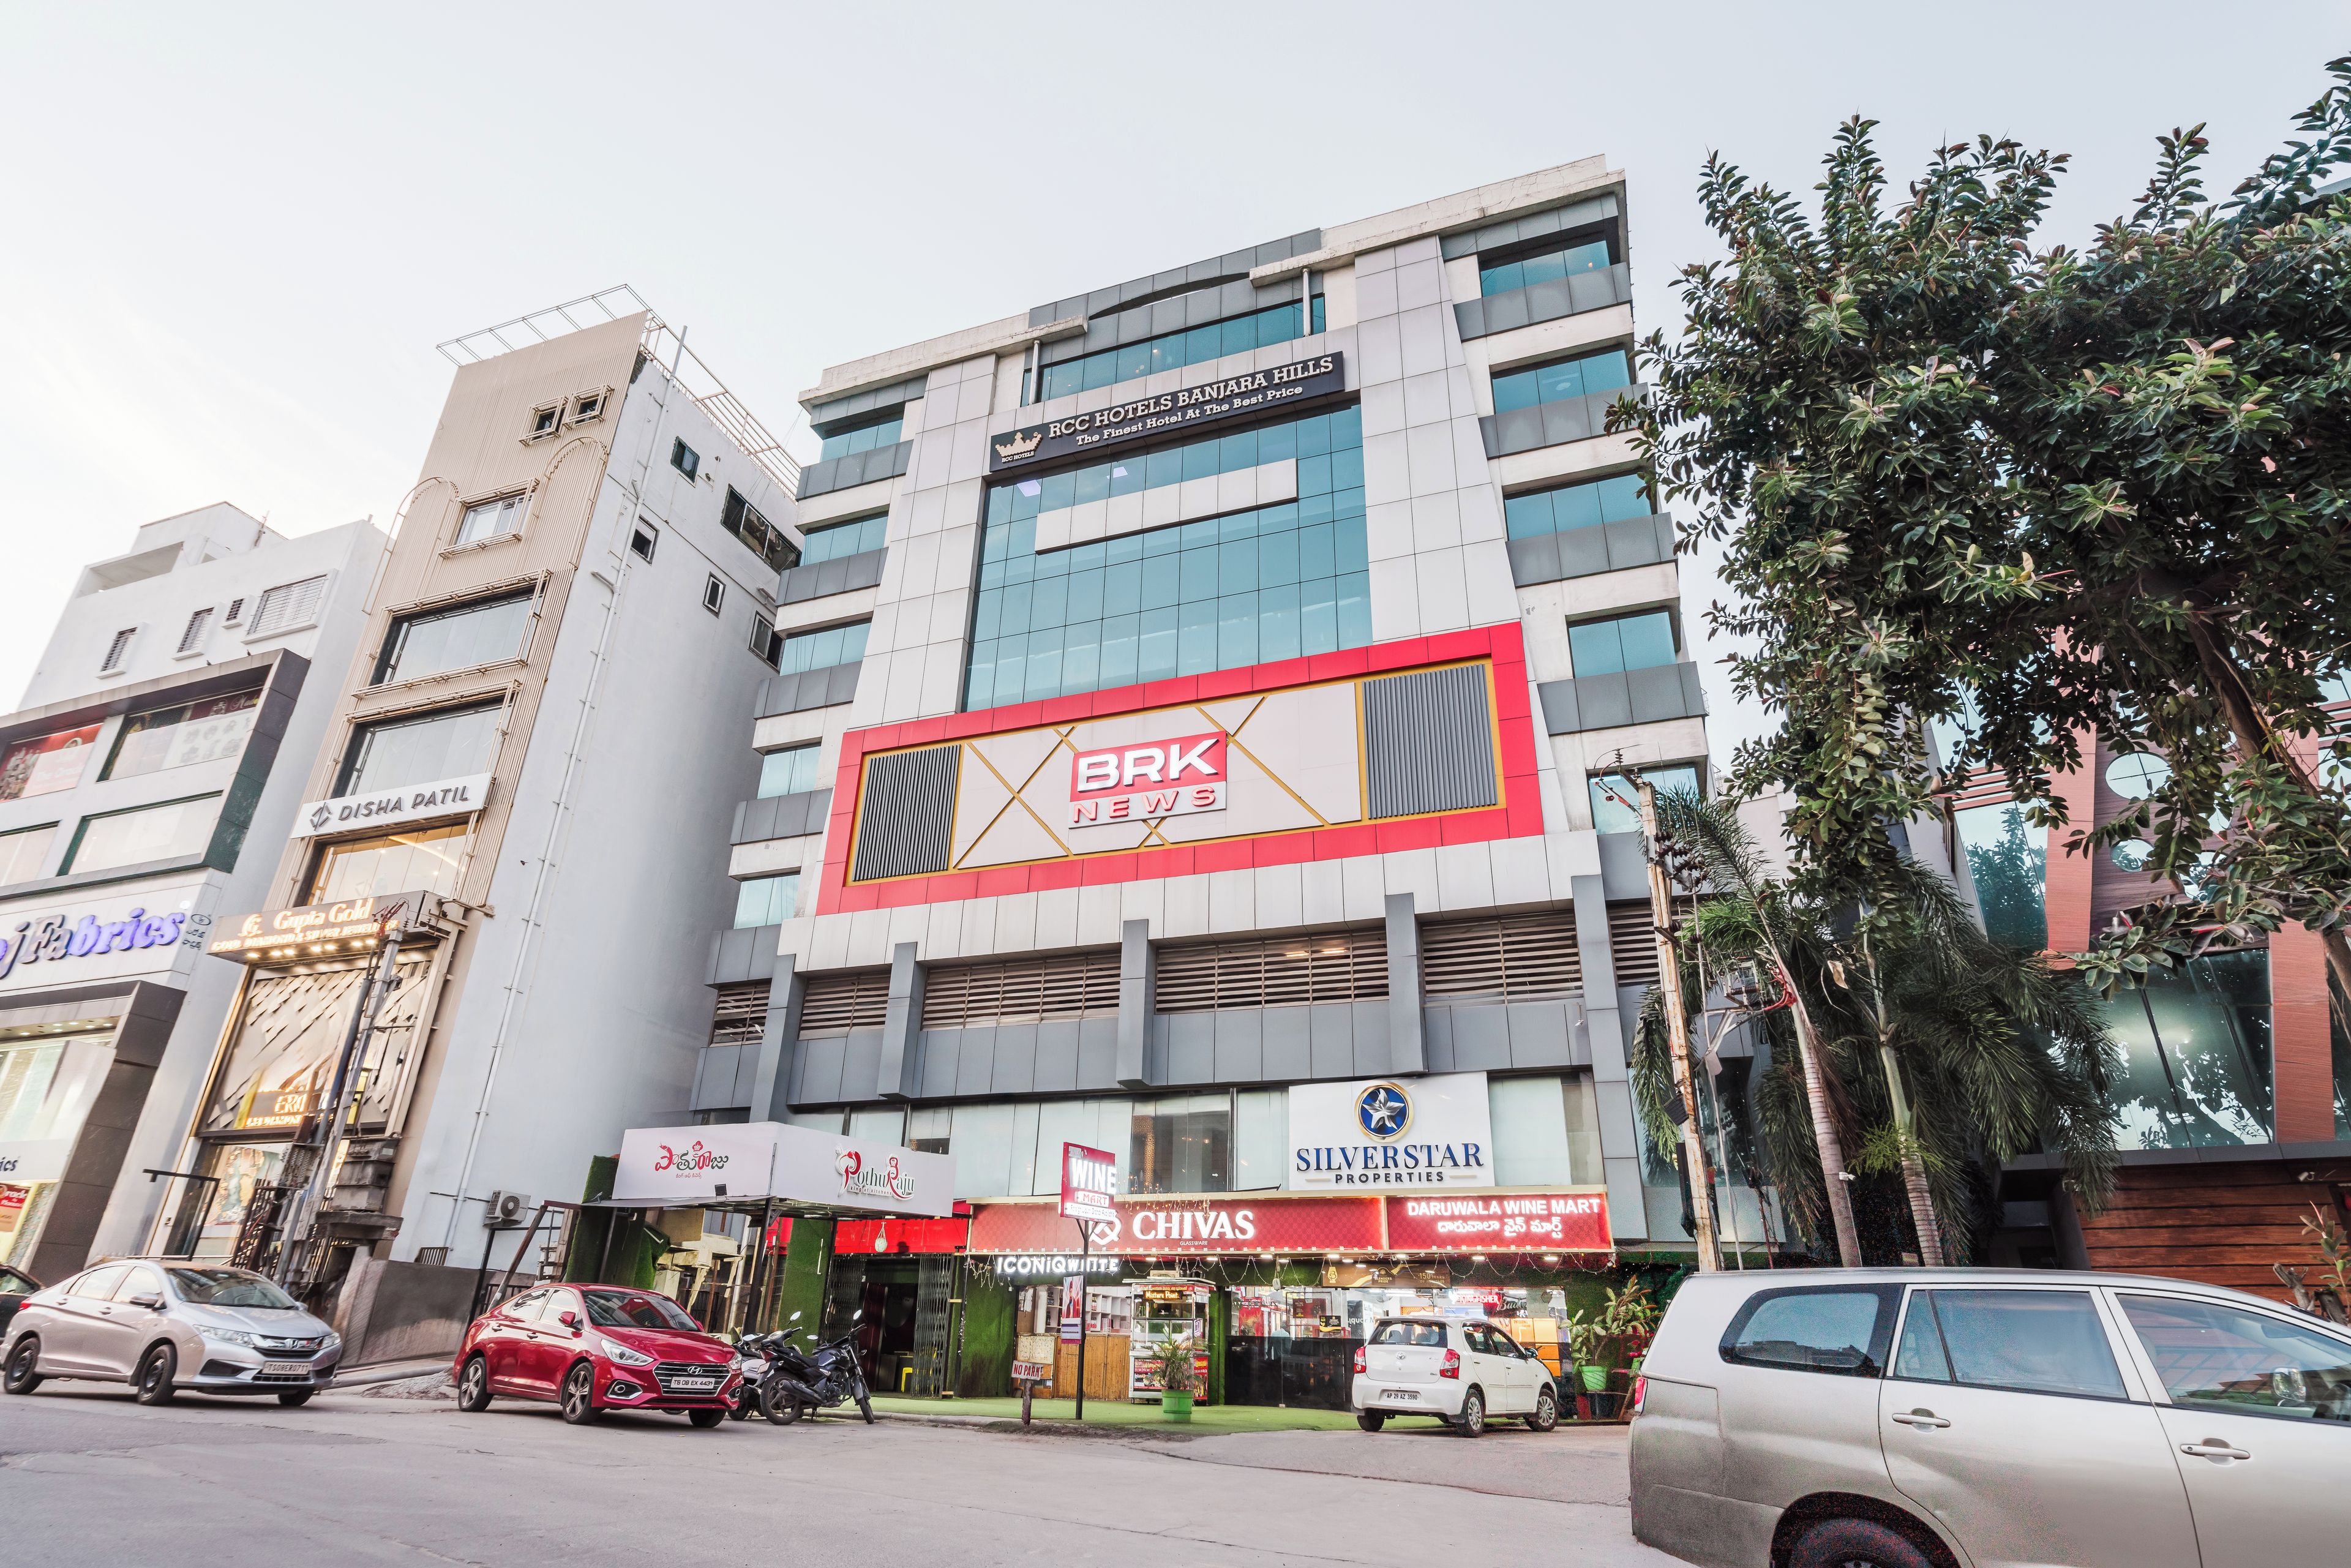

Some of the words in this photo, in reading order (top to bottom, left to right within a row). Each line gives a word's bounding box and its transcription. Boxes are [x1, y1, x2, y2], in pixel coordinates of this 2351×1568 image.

[1049, 415, 1090, 438] RCC
[1095, 395, 1172, 427] HOTELS
[1178, 373, 1268, 408] BANJARA
[1273, 356, 1333, 384] HILLS
[1076, 433, 1100, 446] The
[1103, 422, 1143, 440] Finest
[1146, 412, 1182, 429] Hotel
[1185, 409, 1200, 421] At
[1204, 402, 1229, 416] The
[1232, 393, 1263, 409] Best
[1267, 386, 1303, 400] Price
[1014, 451, 1035, 460] HOTELS
[1077, 738, 1219, 793] BRK
[338, 797, 403, 821] DISHA
[411, 786, 470, 809] PATIL
[1073, 786, 1216, 823] NEWS
[274, 910, 326, 933] Gupta
[328, 897, 374, 923] Gold
[1297, 1143, 1484, 1171] SILVERSTAR
[1069, 1158, 1116, 1195] WINE
[1335, 1171, 1444, 1184] PROPERTIES
[1083, 1194, 1107, 1205] MART
[1408, 1201, 1501, 1215] DARUWALA
[1504, 1199, 1548, 1214] WINE
[1551, 1199, 1600, 1214] MART
[1133, 1211, 1254, 1239] CHIVAS
[1460, 1294, 1499, 1304] KINGFISHER
[1013, 1364, 1023, 1375] NO
[1024, 1365, 1040, 1378] PARK
